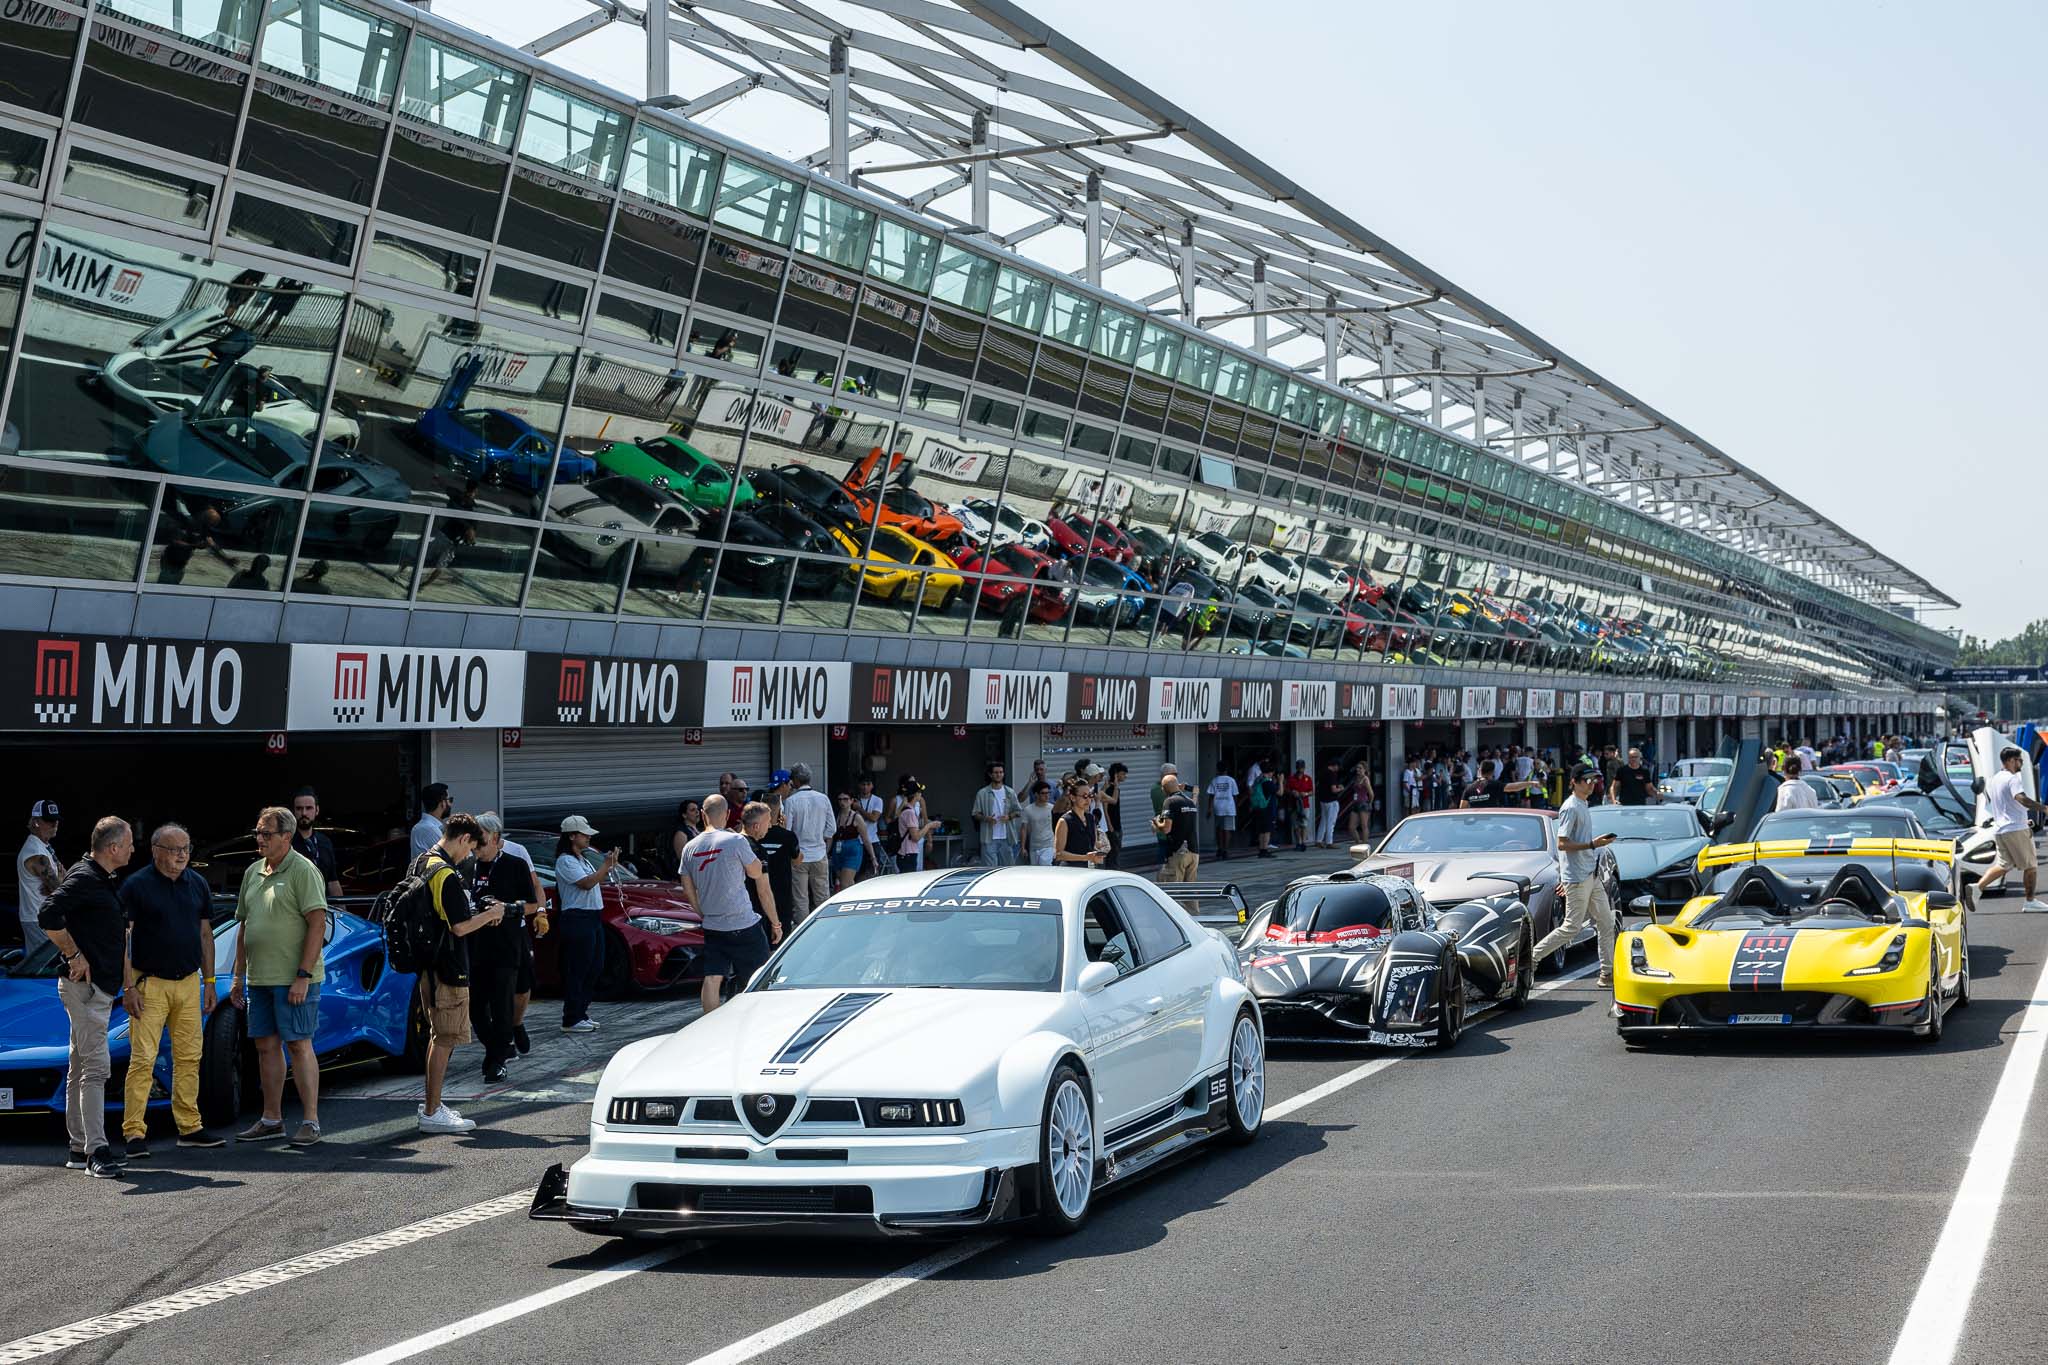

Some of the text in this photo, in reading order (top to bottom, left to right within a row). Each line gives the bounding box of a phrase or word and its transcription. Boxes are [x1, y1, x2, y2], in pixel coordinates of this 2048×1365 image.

[92, 641, 243, 725] MIMO
[376, 653, 489, 724] MIMO
[590, 660, 679, 723] MIMO
[757, 666, 828, 720] MIMO
[892, 669, 951, 721] MIMO
[1003, 675, 1052, 720] MIMO
[1095, 678, 1137, 721] MIMO
[1174, 681, 1210, 720] MIMO
[1241, 682, 1273, 718] MIMO
[1301, 684, 1327, 718] MIMO
[1351, 684, 1376, 717] MIMO
[1395, 687, 1418, 717] MIMO
[1437, 687, 1456, 717] MIMO
[268, 734, 285, 750] 60
[504, 730, 520, 744] 59
[686, 729, 701, 742] 58
[834, 726, 846, 737] 57
[953, 726, 966, 736] 56
[838, 898, 1042, 913] 55-STRADALE
[1736, 961, 1782, 969] 777
[759, 1068, 800, 1076] 55
[1211, 1078, 1227, 1096] 55
